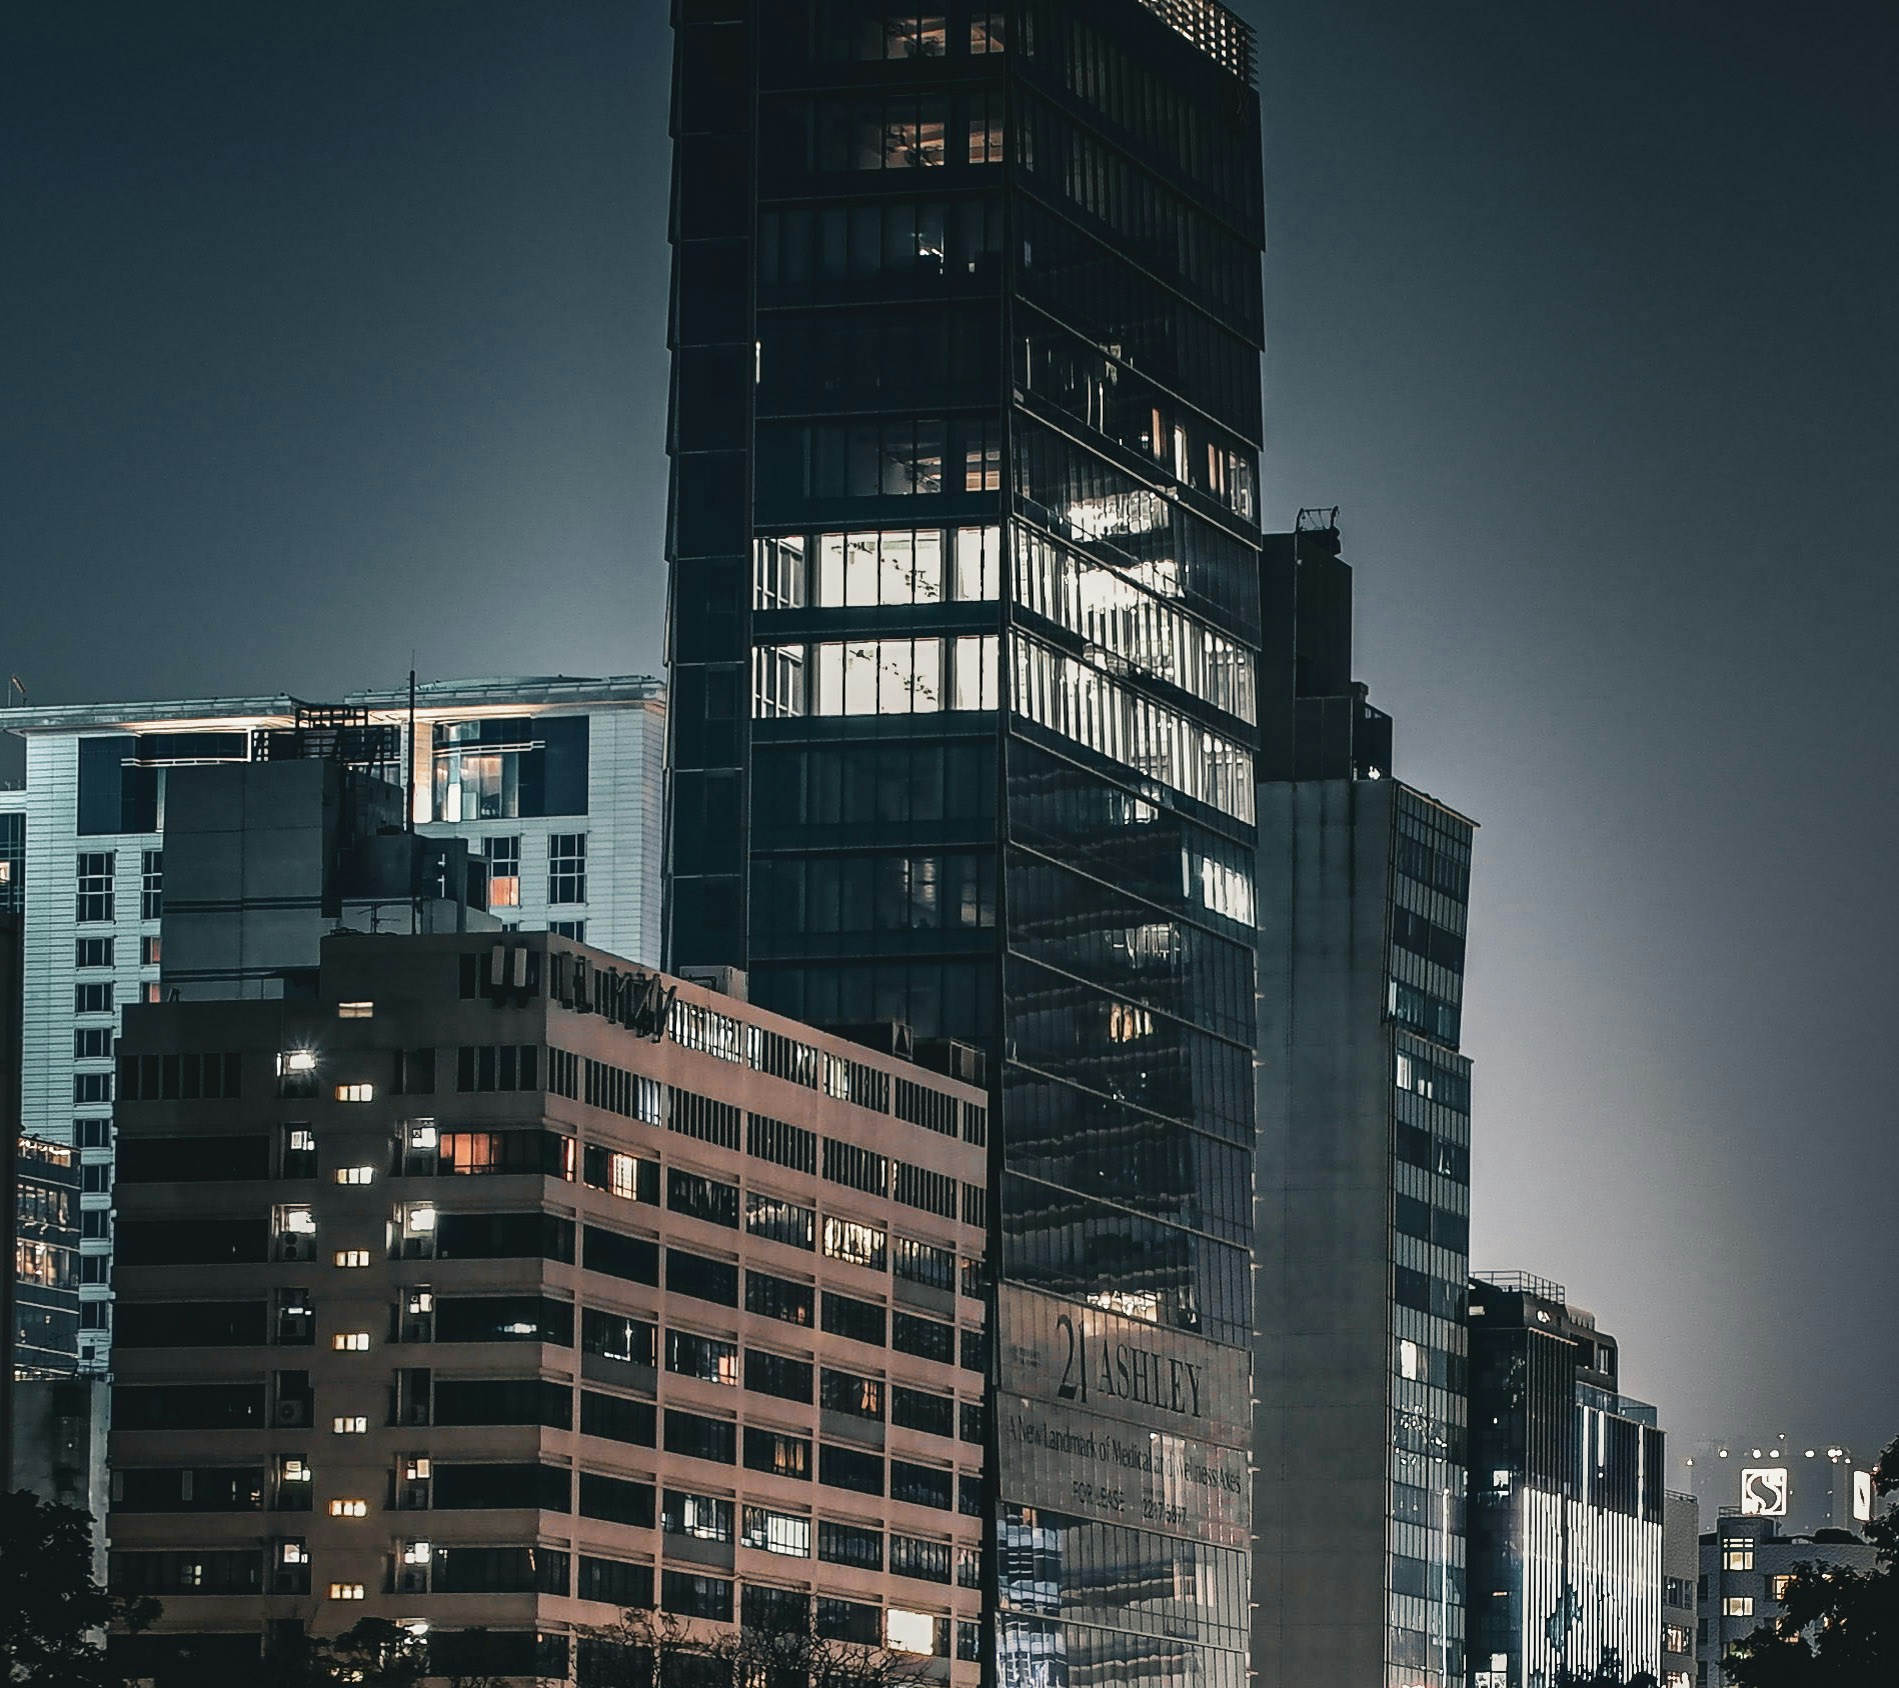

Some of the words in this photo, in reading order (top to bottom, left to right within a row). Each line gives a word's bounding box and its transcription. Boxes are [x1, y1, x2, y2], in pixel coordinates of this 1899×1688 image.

[1057, 1314, 1087, 1403] 21
[1098, 1339, 1202, 1418] ASHLEY
[1009, 1416, 1017, 1440] A
[1018, 1415, 1041, 1445] New
[1043, 1422, 1096, 1458] Landmark
[1099, 1435, 1111, 1461] of
[1112, 1439, 1152, 1473] Medical
[1073, 1480, 1093, 1505] FOR
[1097, 1486, 1125, 1513] LEASE
